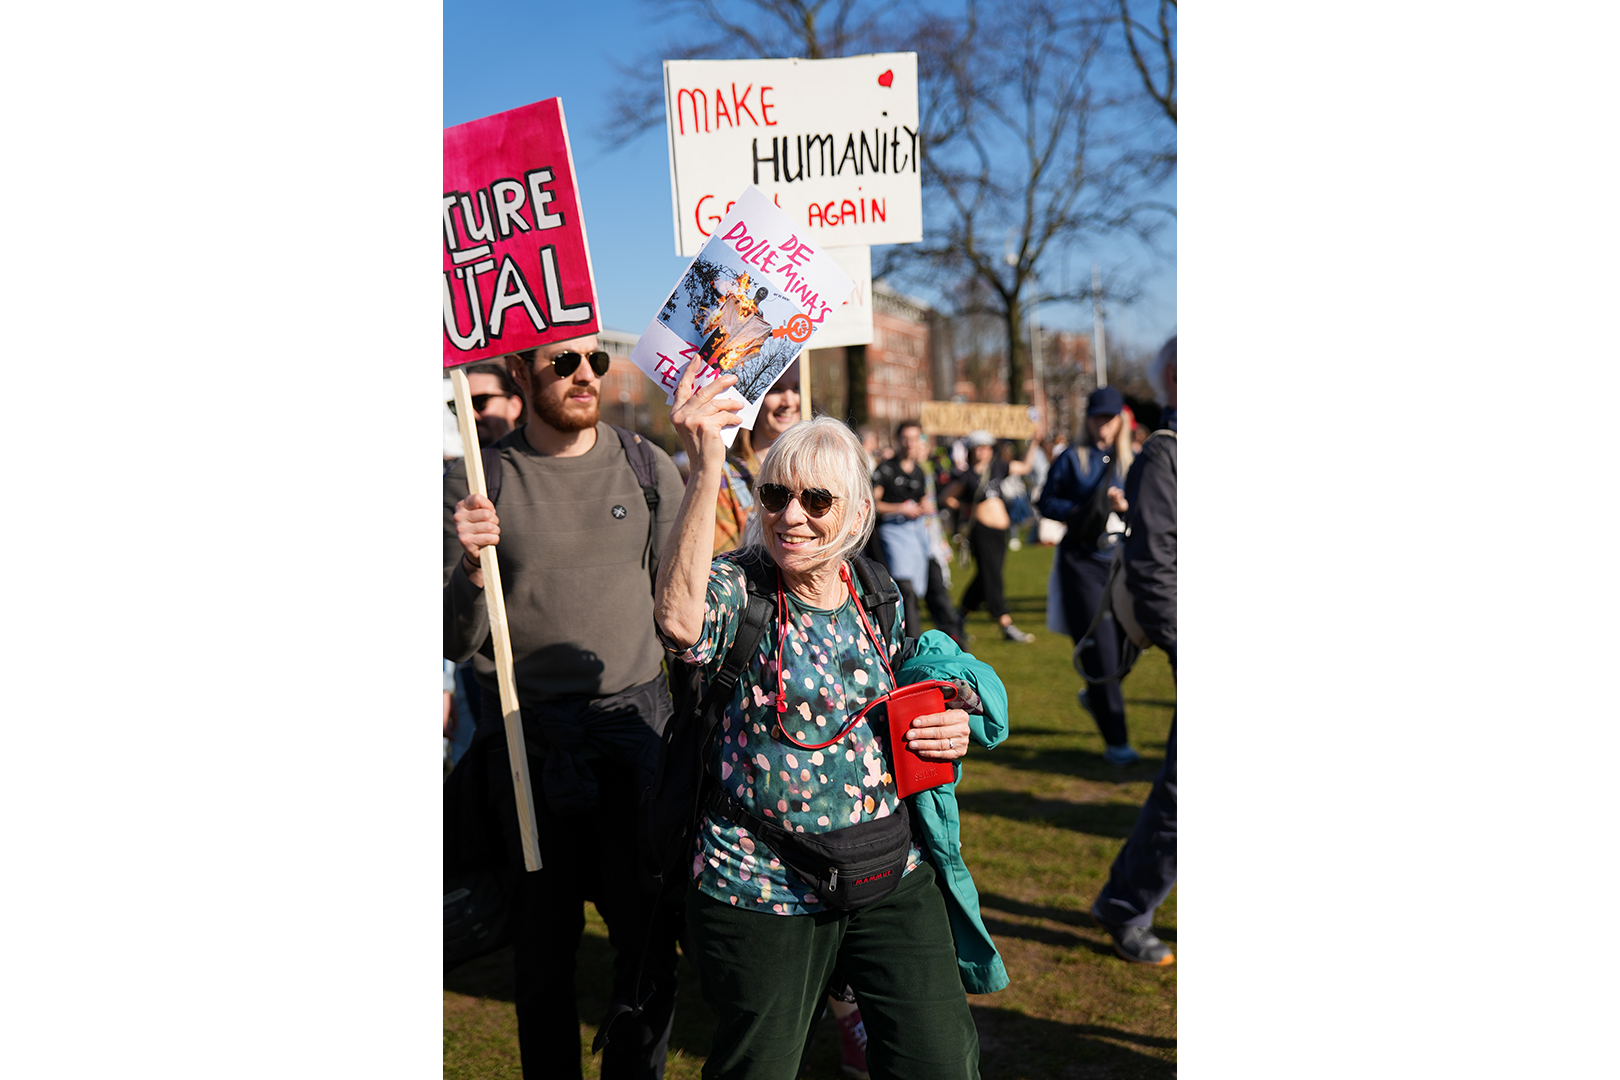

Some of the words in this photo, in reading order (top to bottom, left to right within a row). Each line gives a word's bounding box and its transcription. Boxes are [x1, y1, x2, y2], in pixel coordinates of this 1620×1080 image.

[678, 83, 778, 135] MAKE
[721, 221, 779, 274] DOLLE
[778, 234, 814, 266] DE
[856, 870, 891, 885] MAMMUT
